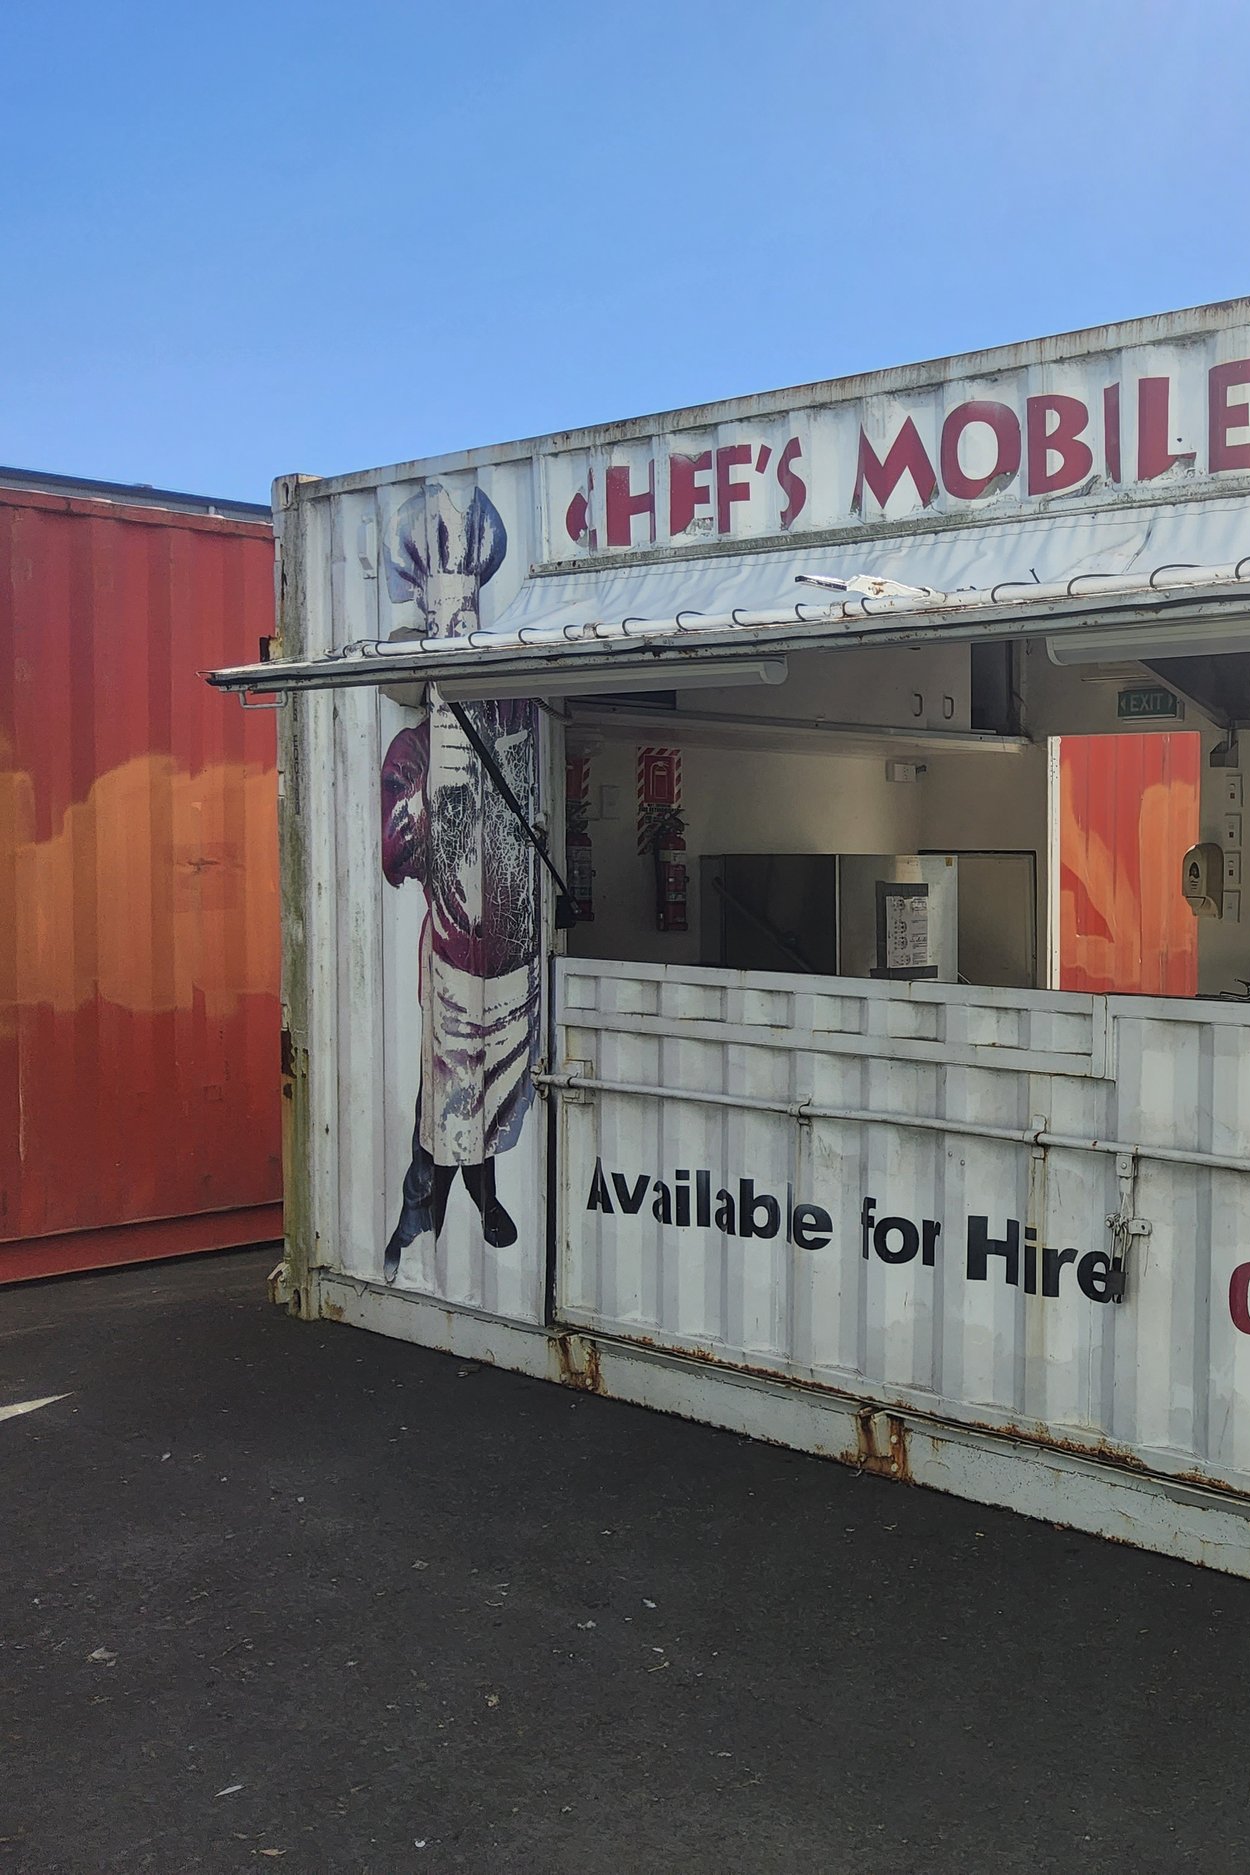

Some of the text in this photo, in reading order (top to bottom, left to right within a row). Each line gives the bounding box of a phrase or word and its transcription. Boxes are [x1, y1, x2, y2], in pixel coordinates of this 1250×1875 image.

[565, 436, 807, 547] CHEF'S
[1130, 693, 1163, 712] EXIT
[586, 1156, 1122, 1304] Available for Hire
